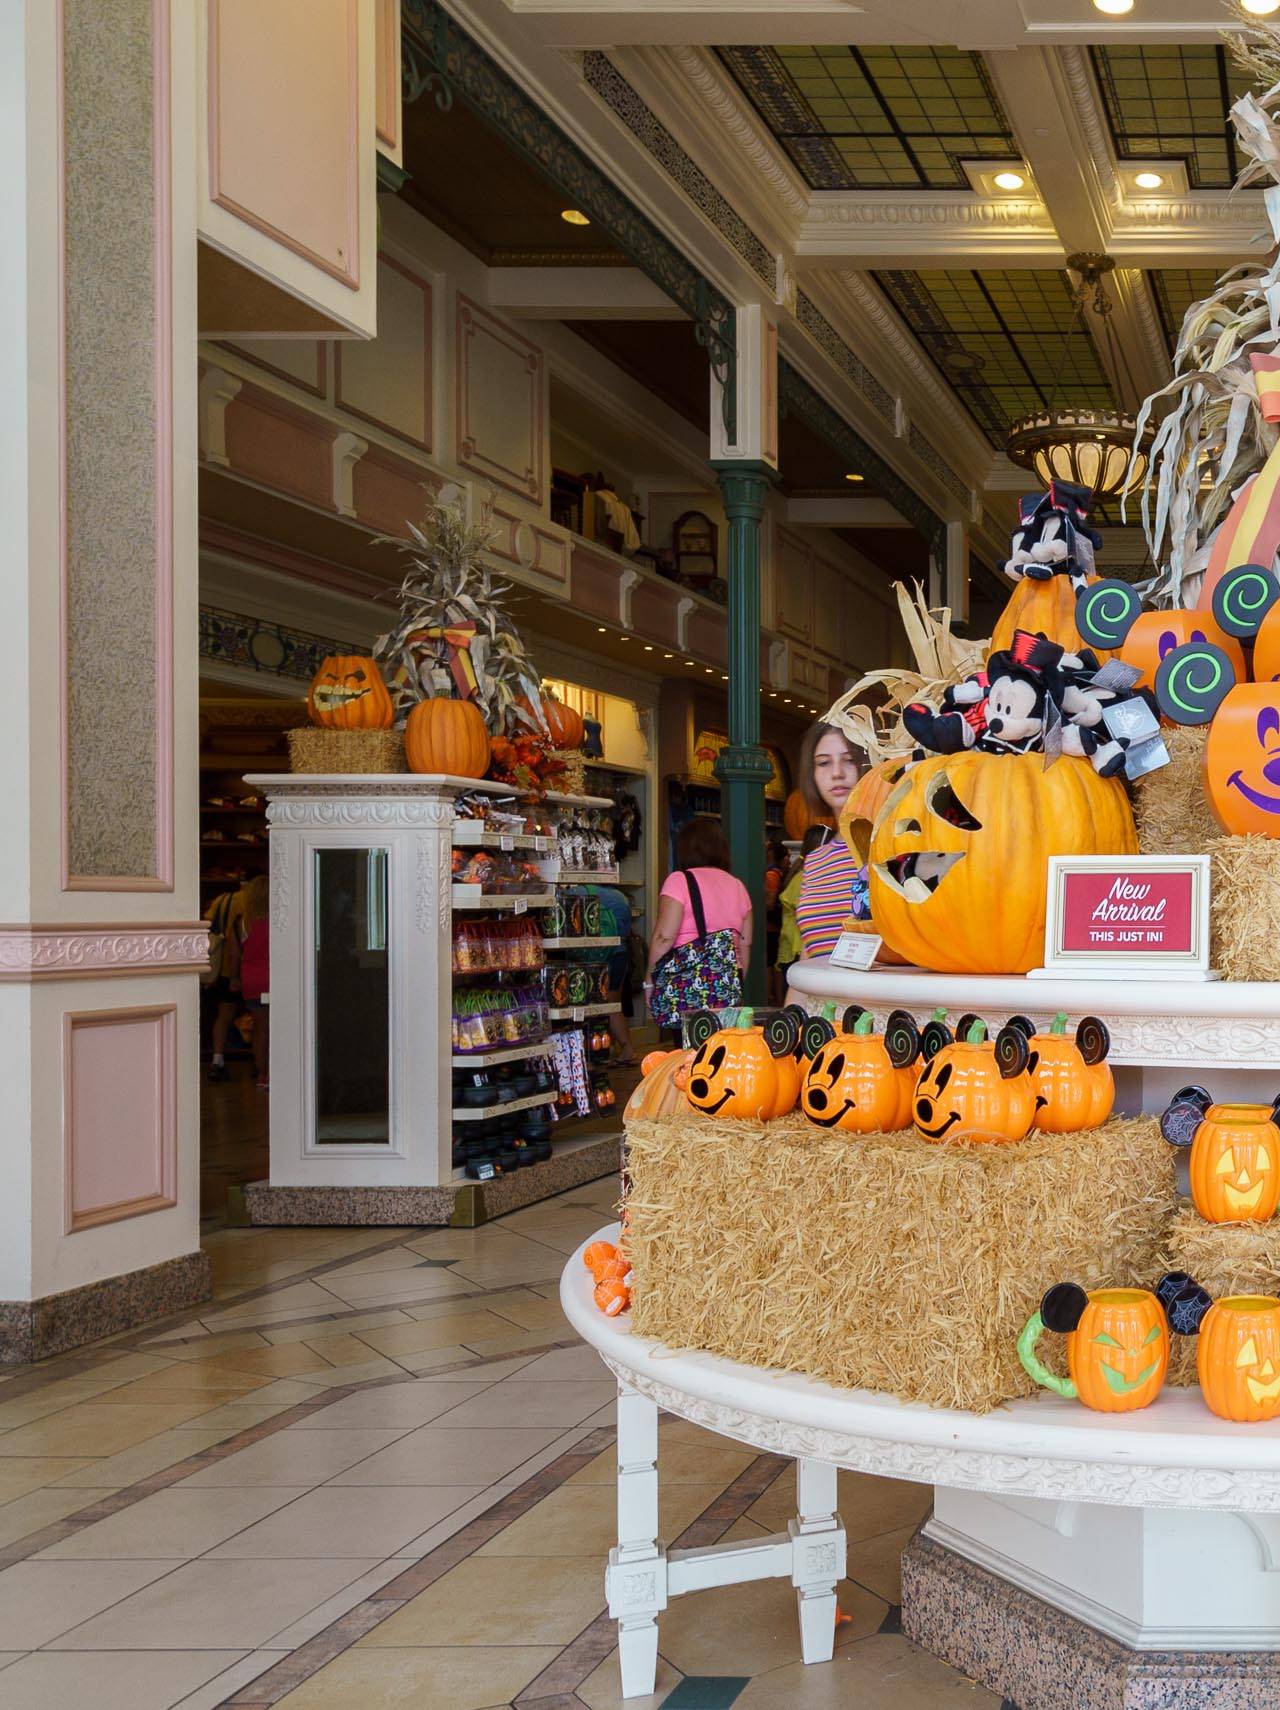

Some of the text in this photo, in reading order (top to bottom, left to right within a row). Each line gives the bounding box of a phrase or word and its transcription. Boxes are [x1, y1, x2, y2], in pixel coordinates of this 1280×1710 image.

[1108, 876, 1151, 900] New
[1091, 898, 1167, 922] Arrival
[1089, 931, 1164, 942] THIS JUST IN!
